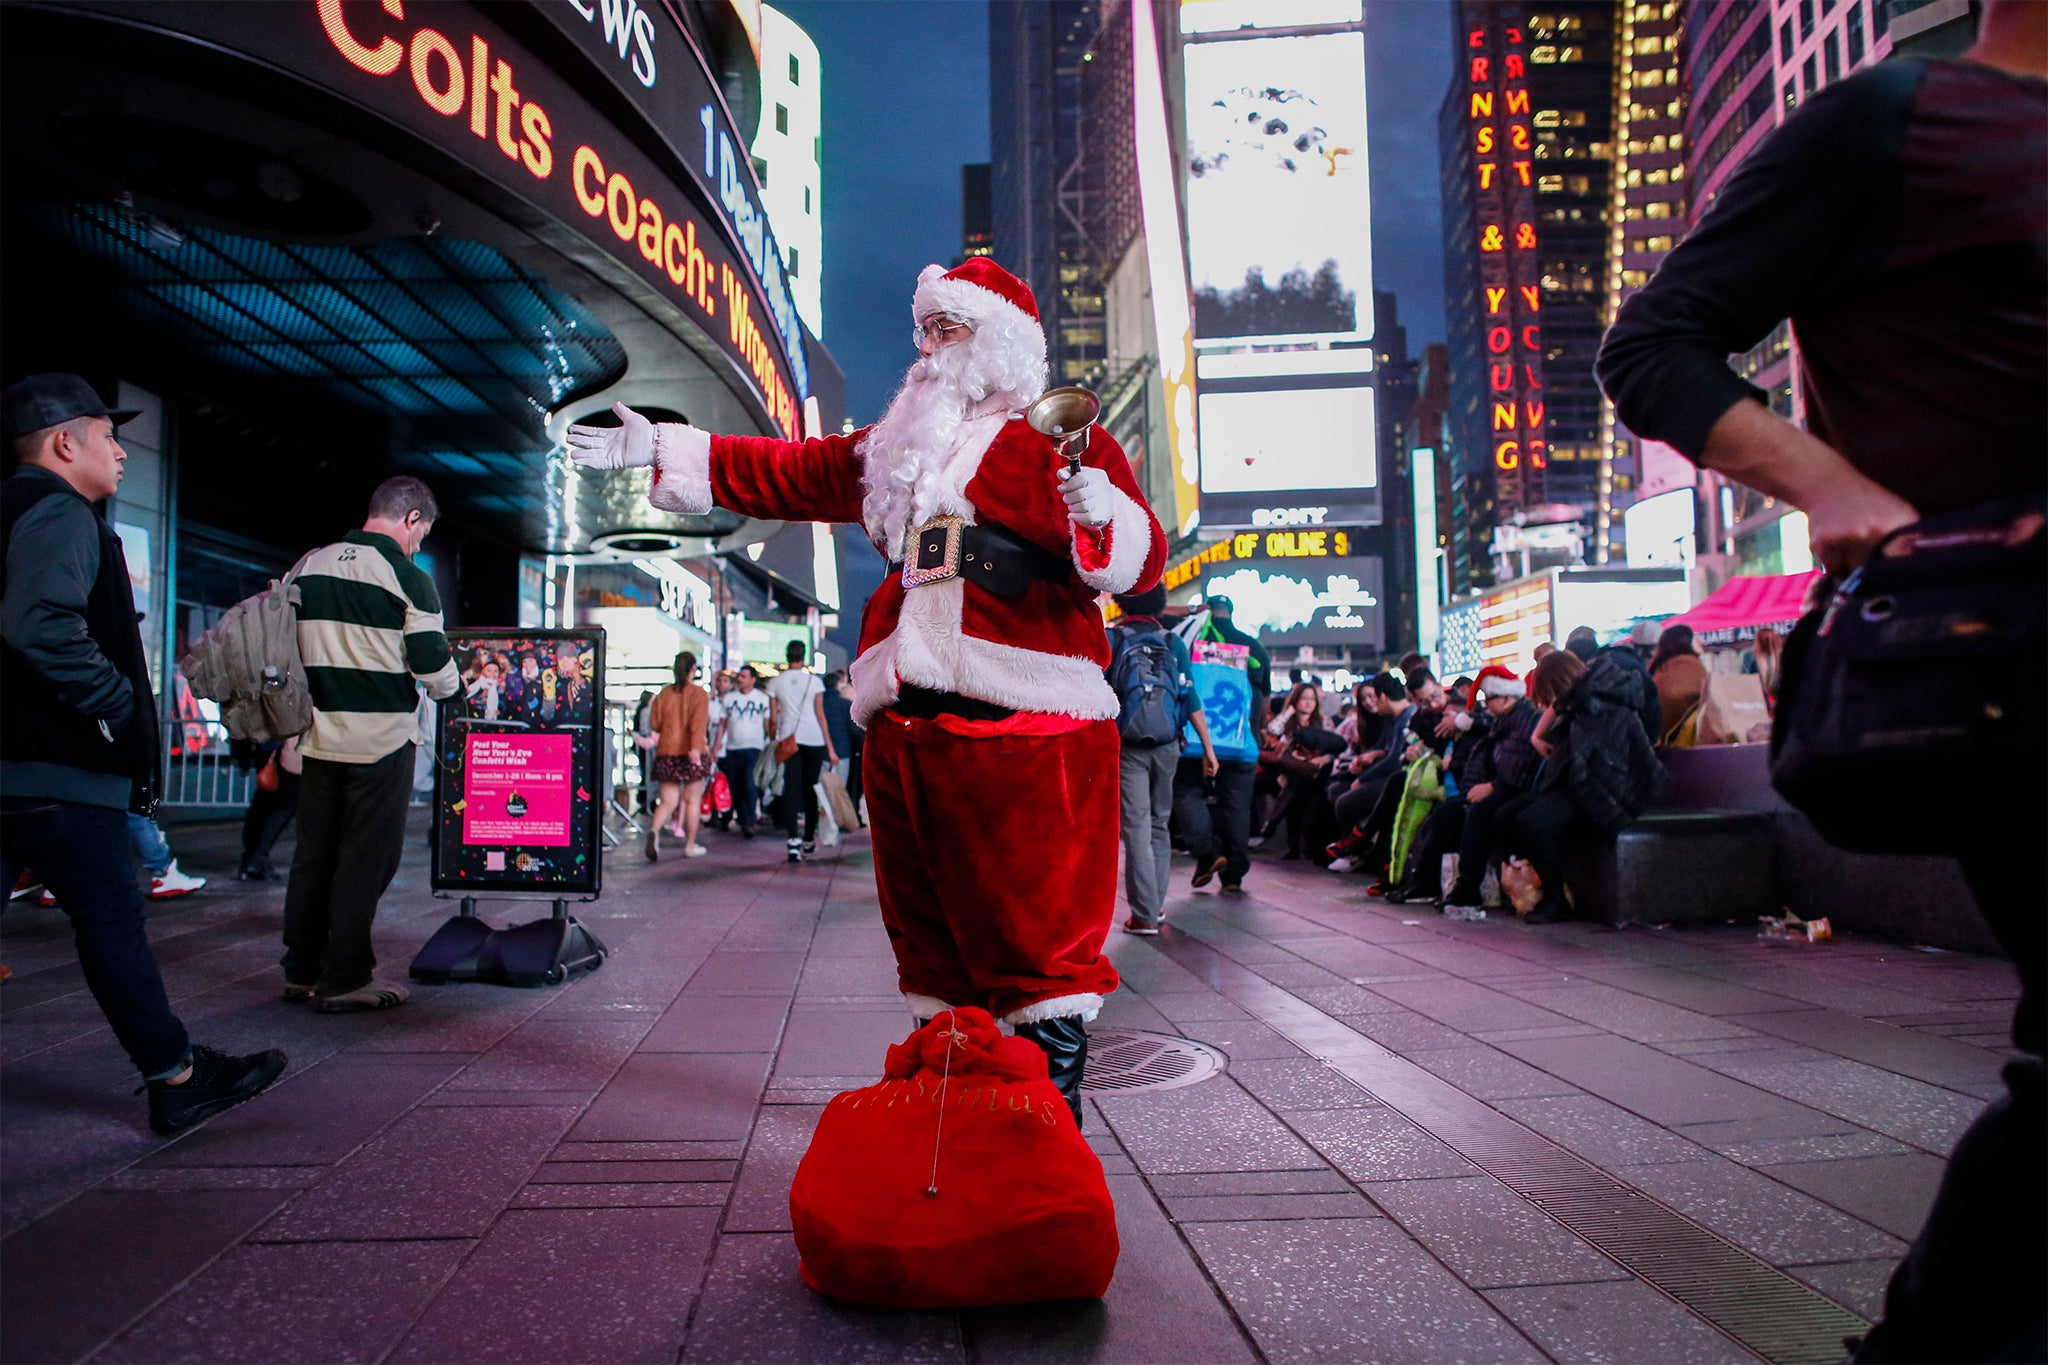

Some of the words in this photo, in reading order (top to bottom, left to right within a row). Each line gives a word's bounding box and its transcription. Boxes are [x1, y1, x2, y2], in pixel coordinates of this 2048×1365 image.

[567, 0, 657, 88] WS
[1469, 28, 1498, 190] ERNST
[700, 103, 715, 178] 1
[316, 0, 554, 179] Colts
[572, 144, 716, 316] coach:
[1480, 224, 1505, 252] &
[1486, 287, 1520, 471] YOUNG
[1252, 507, 1328, 526] SONY
[1234, 533, 1259, 558] OF
[472, 748, 491, 757] New
[516, 749, 533, 758] Eve
[492, 740, 510, 749] Your
[471, 756, 505, 765] Confetti
[506, 757, 527, 765] Wish
